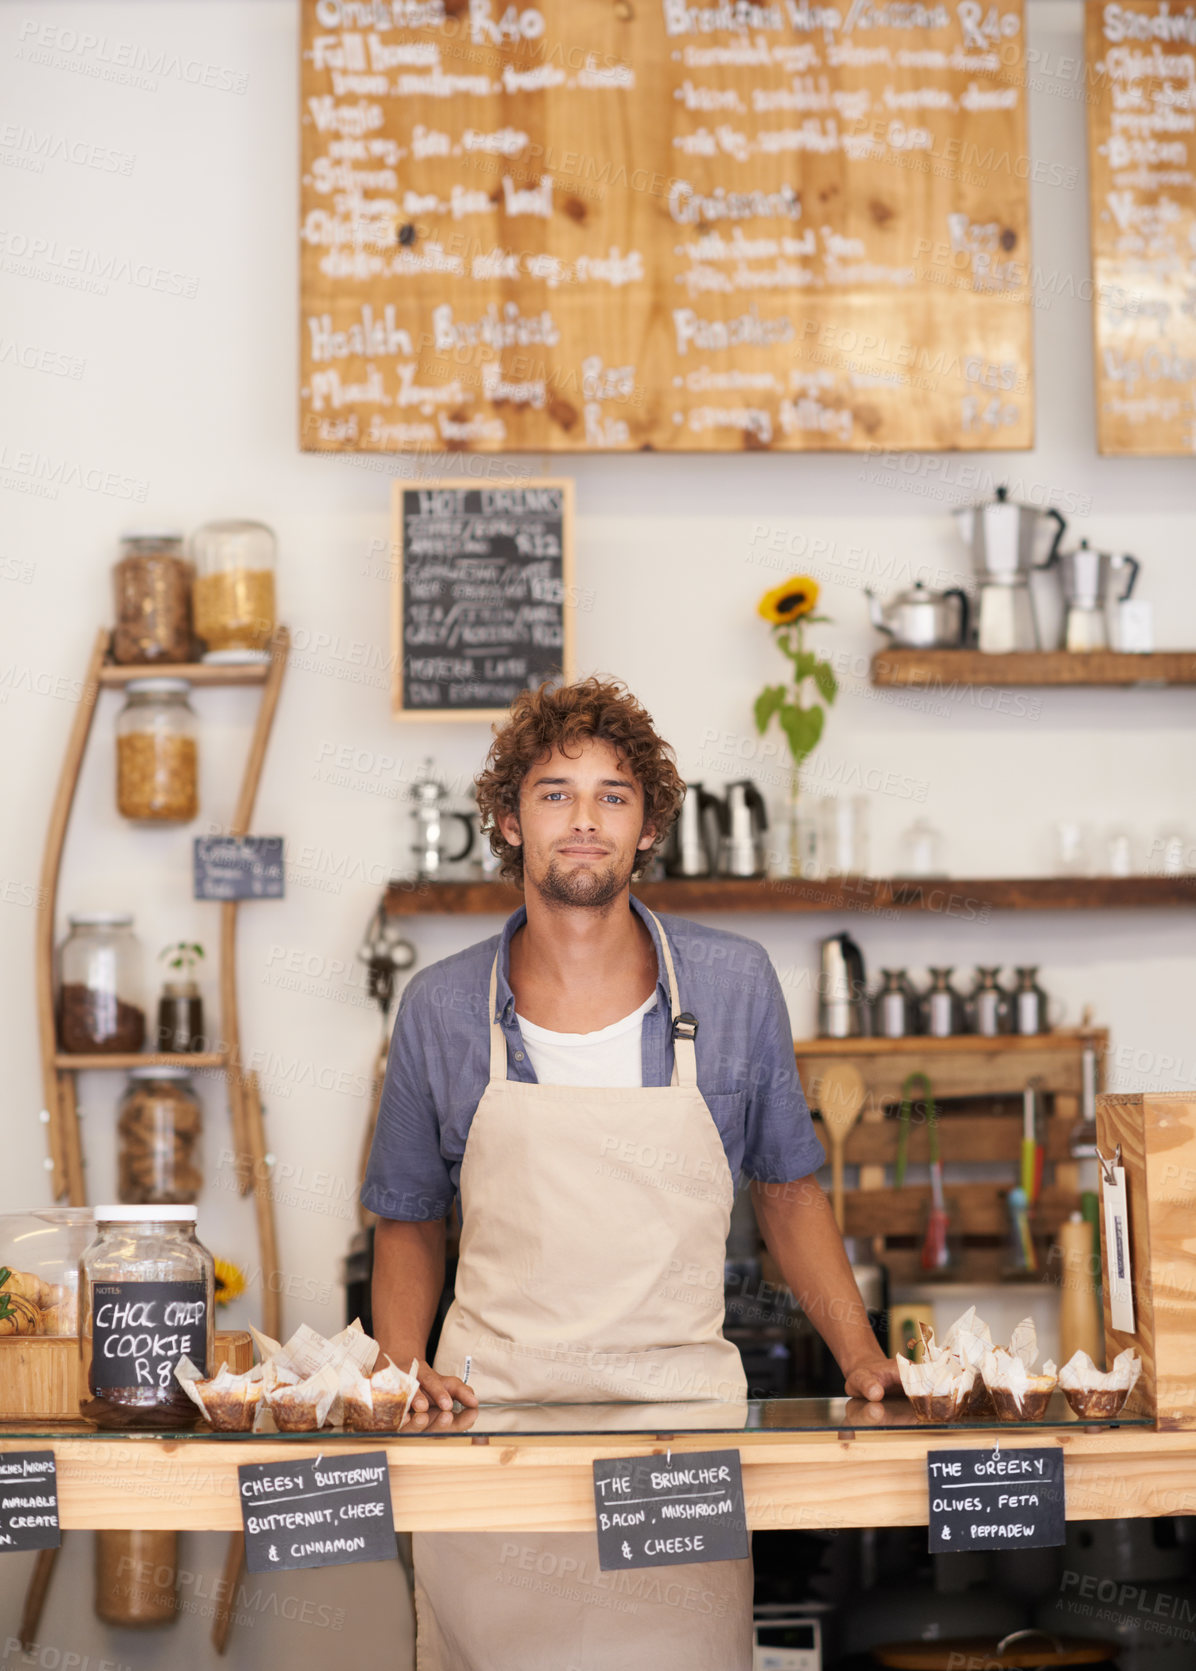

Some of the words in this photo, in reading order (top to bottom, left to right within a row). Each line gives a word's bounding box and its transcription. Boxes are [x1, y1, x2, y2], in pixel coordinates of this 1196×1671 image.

[163, 1301, 206, 1327] CHIP
[103, 1333, 192, 1358] COOKIE
[930, 1462, 962, 1477] THE
[974, 1458, 1043, 1476] GREEKY
[241, 1475, 304, 1497] CHEESY
[314, 1466, 386, 1487] BUTTERNUT
[596, 1476, 632, 1496] THE
[650, 1465, 732, 1489] BRUNCHER
[2, 1495, 57, 1509] AVAILABLE
[661, 1499, 733, 1520] MUSHROOM
[998, 1494, 1039, 1508] FETA
[9, 1515, 58, 1528] CREATE
[247, 1508, 338, 1534] BUTTERNUT,
[339, 1502, 385, 1519] CHEESE
[970, 1523, 1035, 1539] PEPPADEW
[290, 1536, 366, 1557] CINNAMON
[644, 1535, 705, 1556] CHEESE
